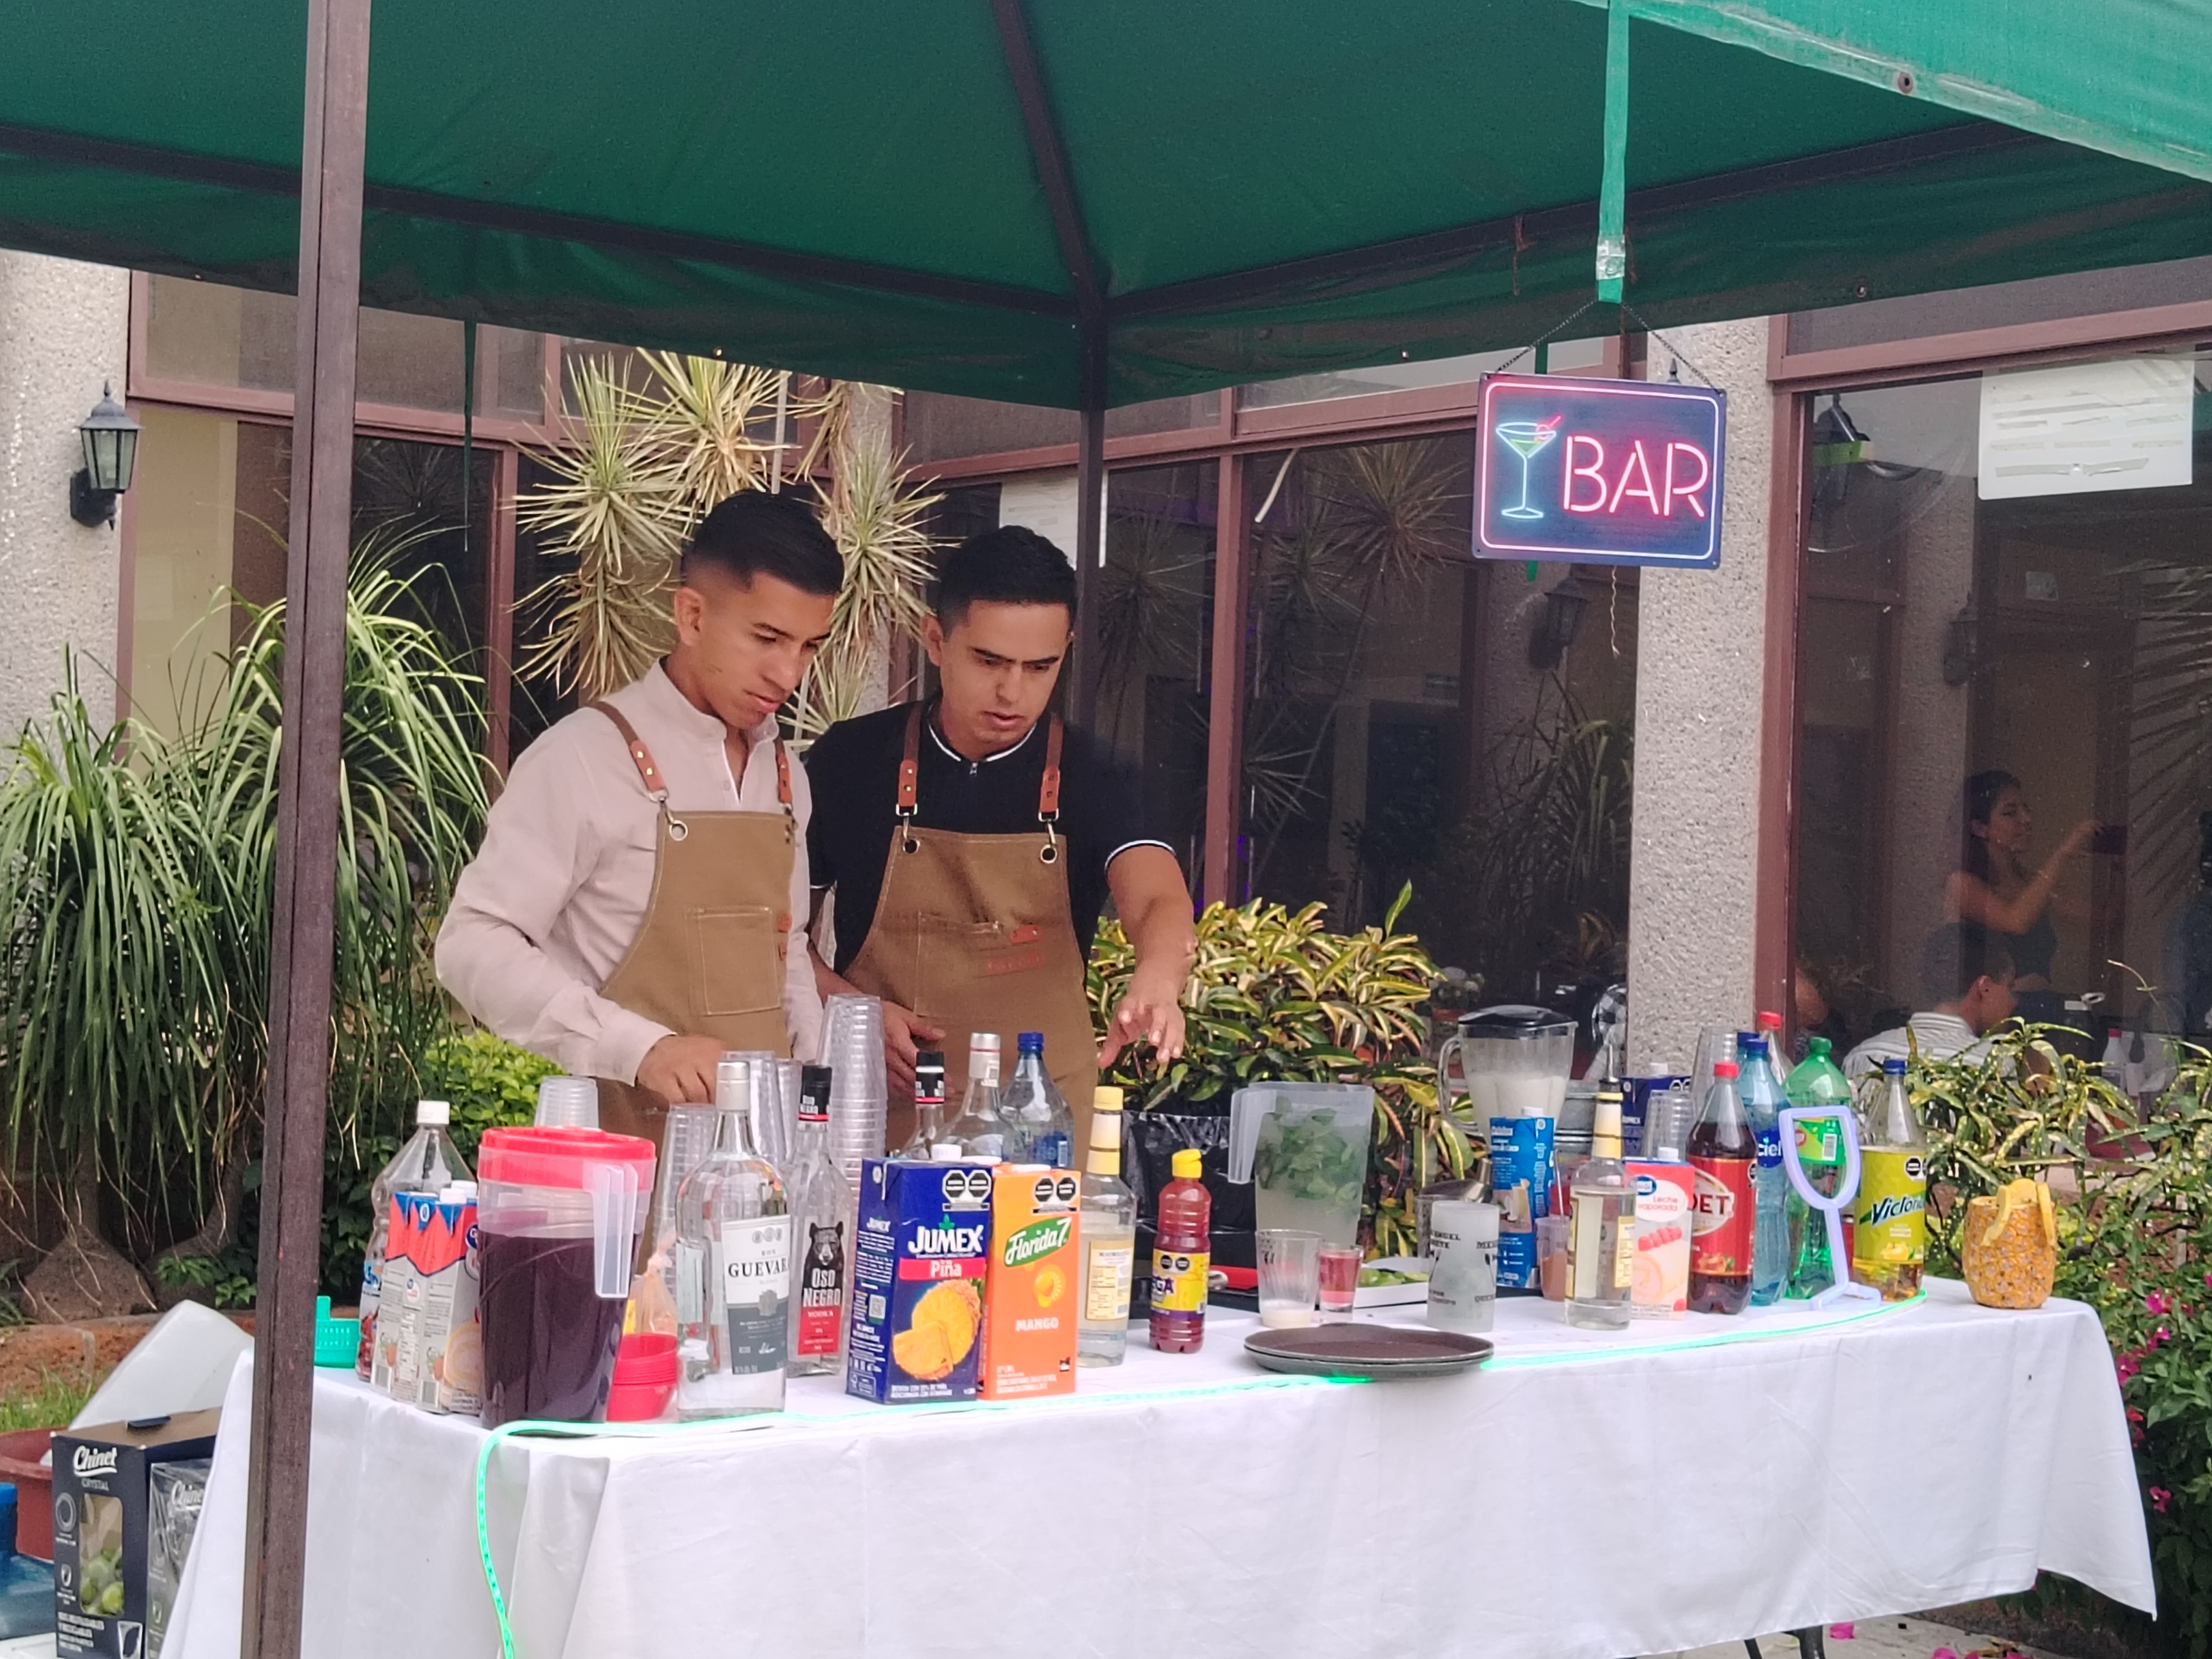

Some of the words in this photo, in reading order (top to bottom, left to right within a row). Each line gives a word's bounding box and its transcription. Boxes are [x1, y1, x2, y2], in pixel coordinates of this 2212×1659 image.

[1564, 435, 1705, 517] BAR
[908, 1225, 984, 1253] JUMEX
[812, 1268, 835, 1288] OSO
[930, 1260, 962, 1277] Piña
[803, 1287, 841, 1307] NEGRO
[1015, 1317, 1058, 1331] MANGO
[73, 1446, 117, 1470] Chinet
